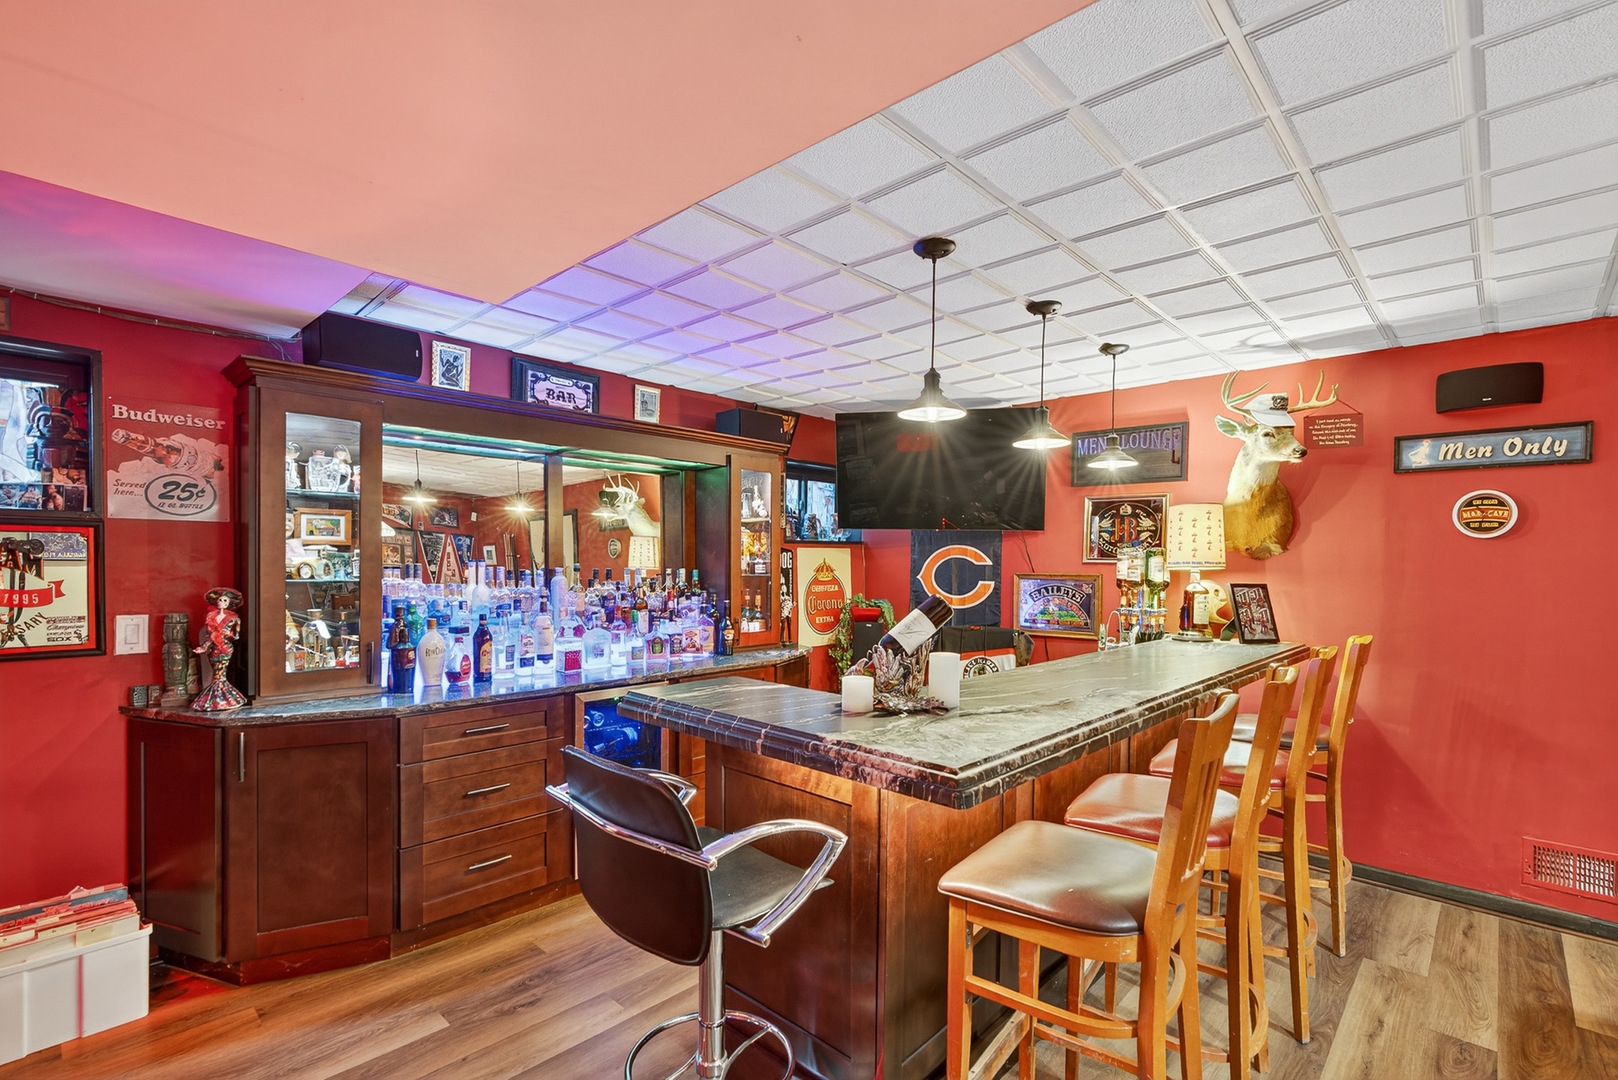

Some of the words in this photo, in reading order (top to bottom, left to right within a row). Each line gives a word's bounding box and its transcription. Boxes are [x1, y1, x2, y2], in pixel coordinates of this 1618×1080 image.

[545, 388, 577, 404] BAR
[112, 404, 226, 430] Budweiser
[1438, 442, 1493, 461] Men
[1503, 436, 1568, 457] Only
[113, 479, 147, 490] Served
[3, 593, 39, 605] 1995
[807, 595, 844, 615] Corona
